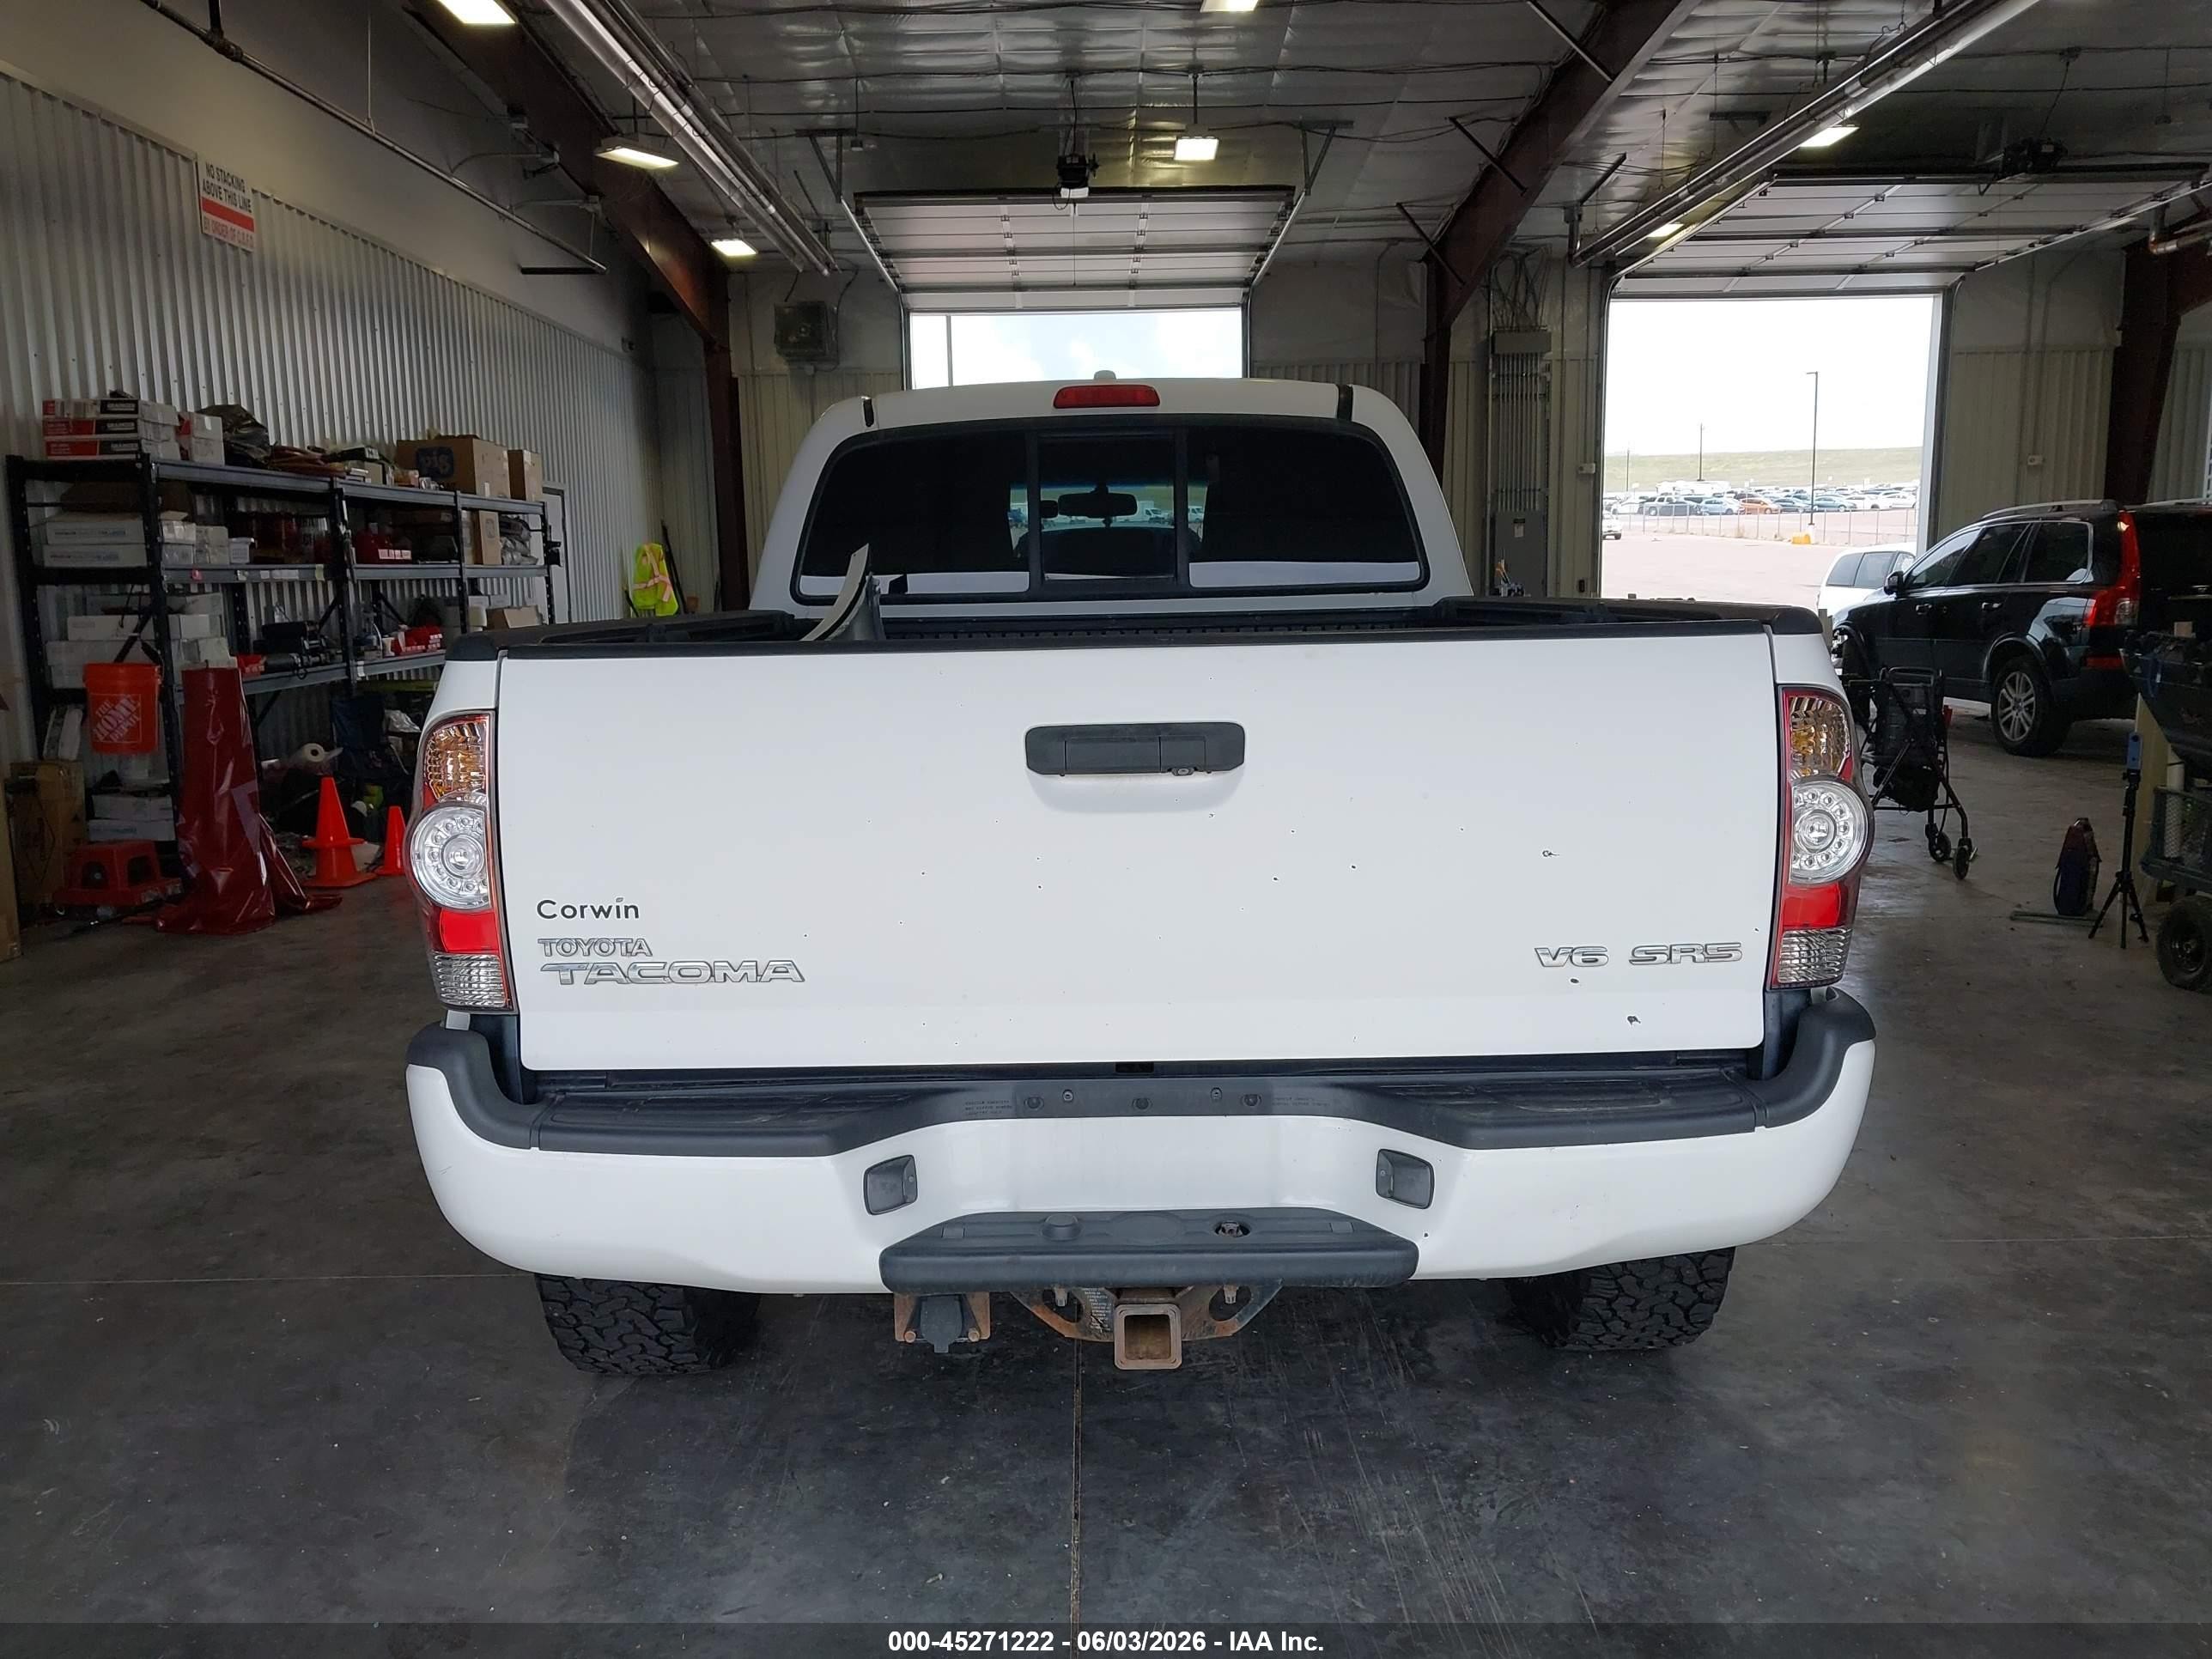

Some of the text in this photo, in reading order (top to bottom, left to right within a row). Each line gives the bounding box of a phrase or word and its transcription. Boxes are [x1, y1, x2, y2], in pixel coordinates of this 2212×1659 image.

[205, 161, 246, 193] NO STACKING
[202, 179, 252, 214] ABOVE THIS LINE
[94, 695, 139, 742] HOME
[95, 700, 112, 718] THE
[110, 714, 140, 743] DEPOT
[536, 896, 640, 921] Corwin
[537, 938, 653, 957] TOYOTA
[1534, 942, 1743, 968] V6 SR5
[540, 959, 805, 985] TACOMA
